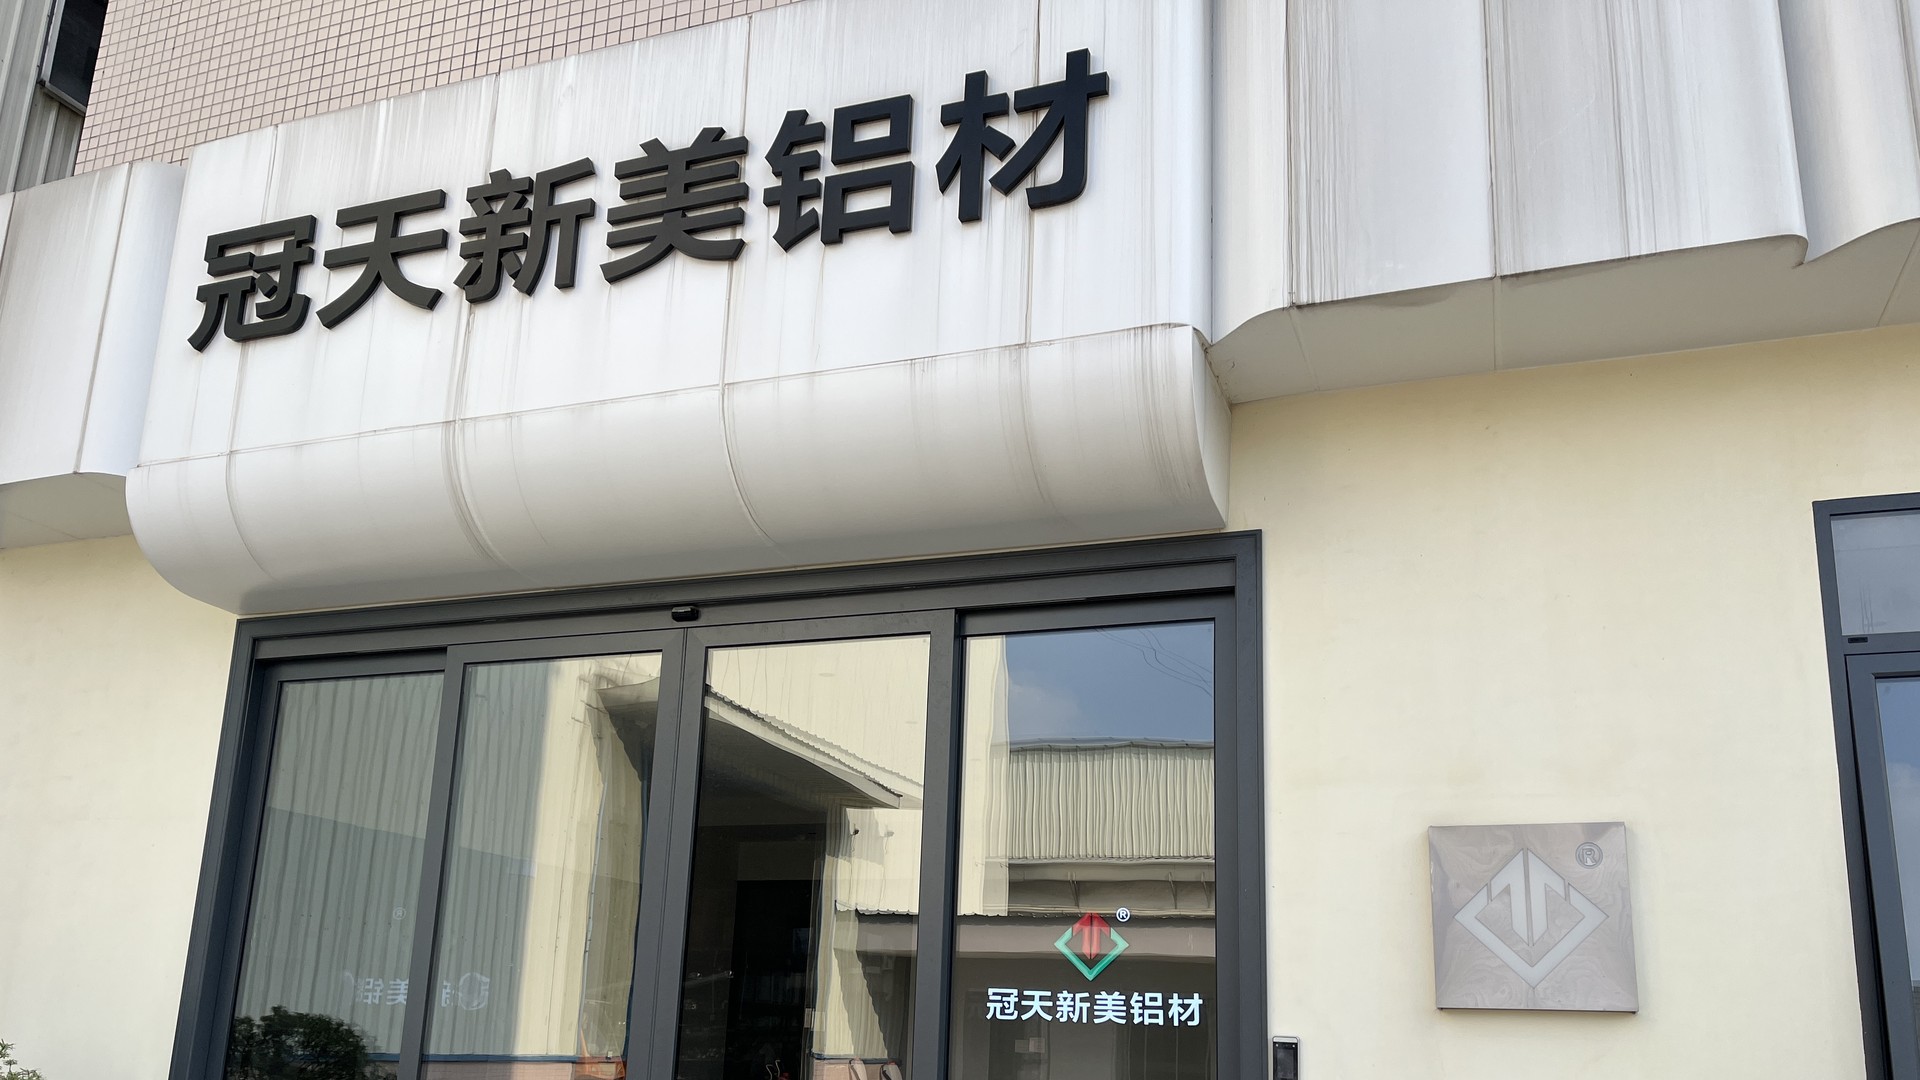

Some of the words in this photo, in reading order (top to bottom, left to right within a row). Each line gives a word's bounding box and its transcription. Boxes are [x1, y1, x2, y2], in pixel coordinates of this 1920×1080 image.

[187, 48, 1108, 352] 冠天新美铝材
[985, 987, 1203, 1027] 冠天新美铝材
